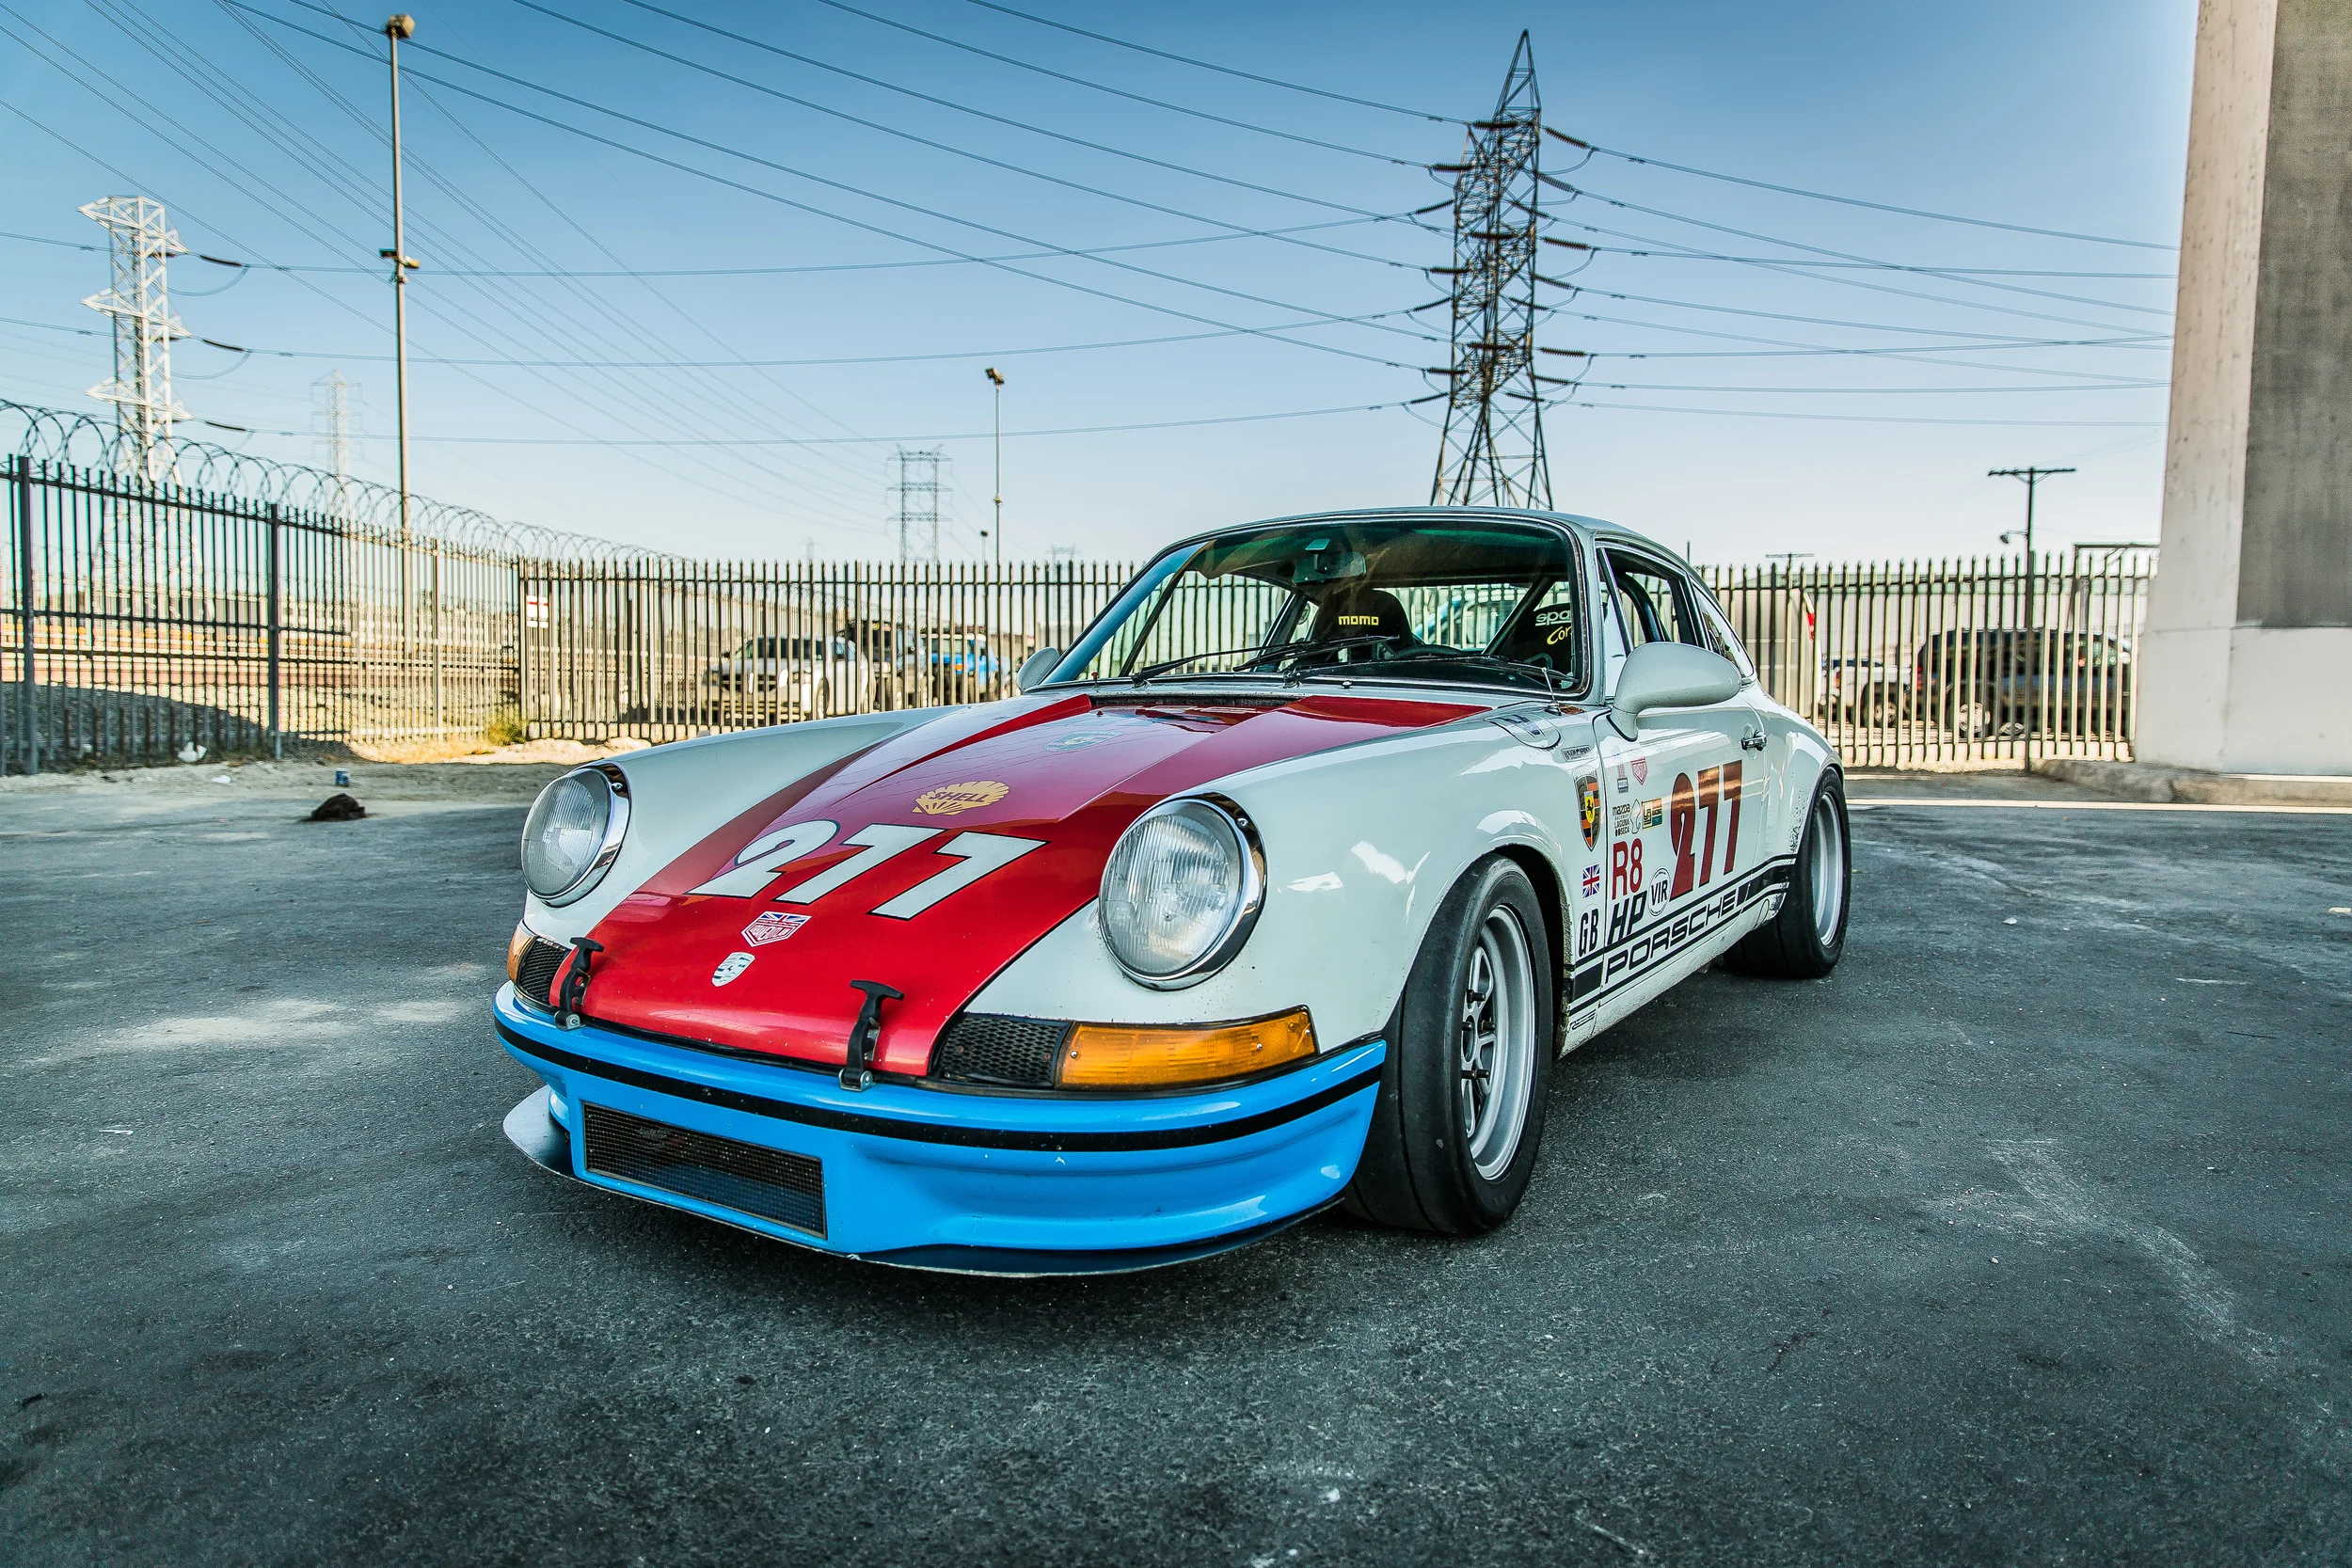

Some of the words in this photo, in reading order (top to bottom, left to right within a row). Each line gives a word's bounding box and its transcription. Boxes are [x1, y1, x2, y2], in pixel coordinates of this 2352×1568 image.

[929, 791, 991, 803] SHELL
[1612, 803, 1630, 816] mazda
[1613, 818, 1629, 829] LAGUNA
[1620, 825, 1629, 835] SECA
[1669, 760, 1742, 902] 277
[686, 819, 1050, 921] 277
[1612, 837, 1643, 900] R8
[1651, 879, 1668, 906] VIR
[1579, 908, 1599, 958] GB
[1605, 889, 1737, 985] PORSCHE
[1607, 890, 1647, 946] HP
